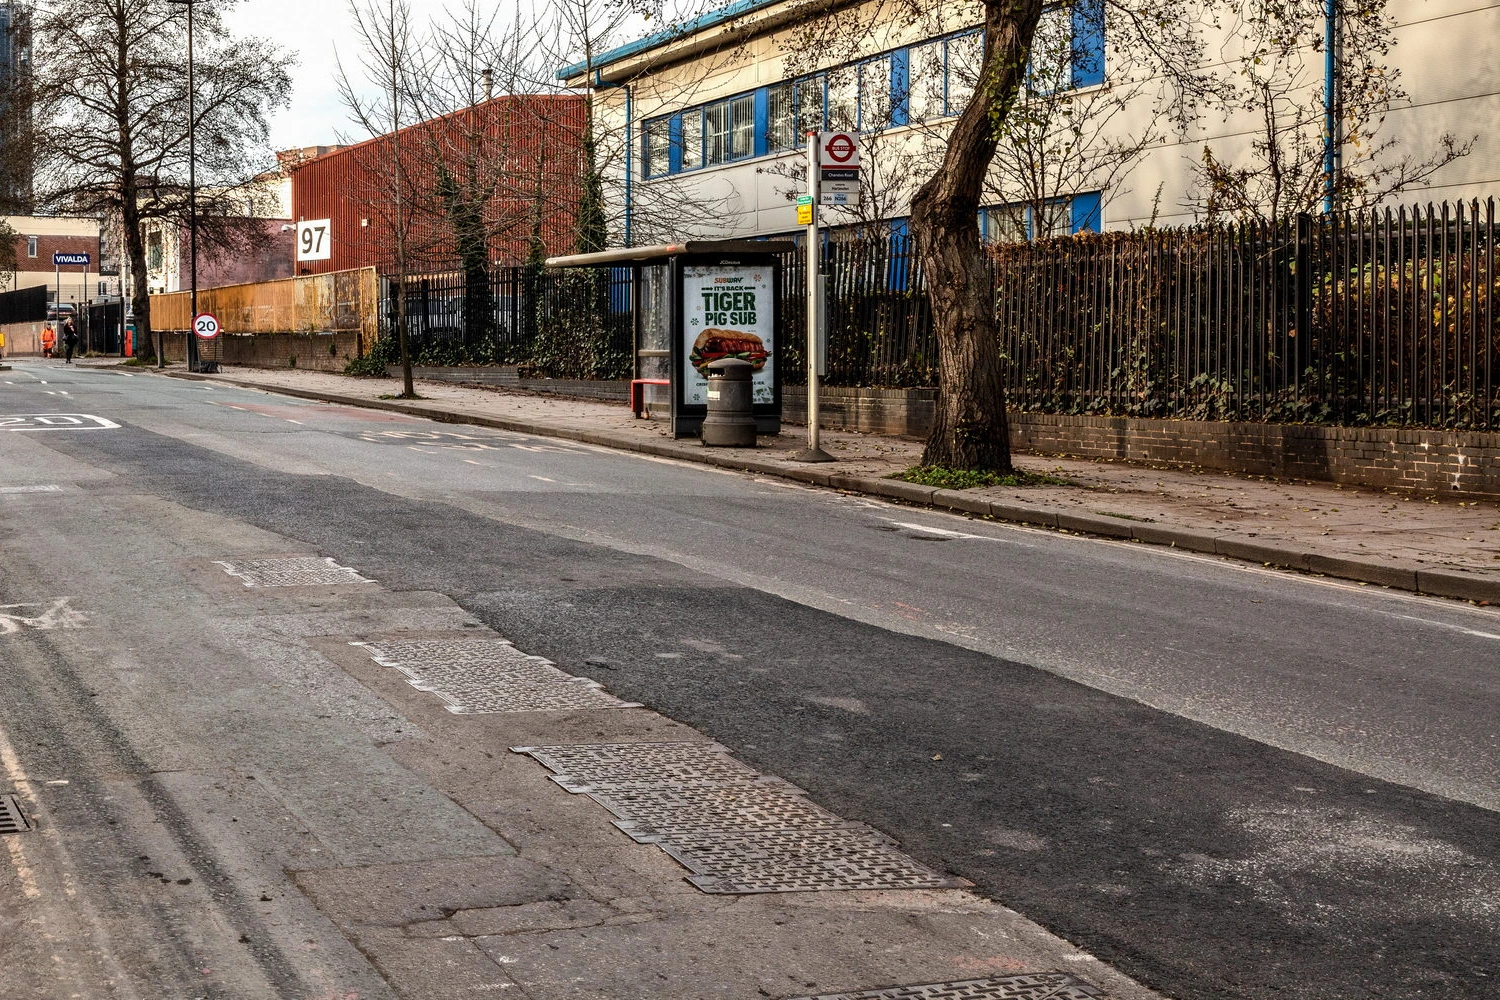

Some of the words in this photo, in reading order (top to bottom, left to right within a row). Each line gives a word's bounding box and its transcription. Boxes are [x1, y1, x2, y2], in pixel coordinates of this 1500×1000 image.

[301, 226, 326, 254] 97
[701, 292, 756, 311] TIGER
[196, 321, 216, 332] 20
[705, 312, 727, 326] PIG
[729, 311, 757, 325] SUB
